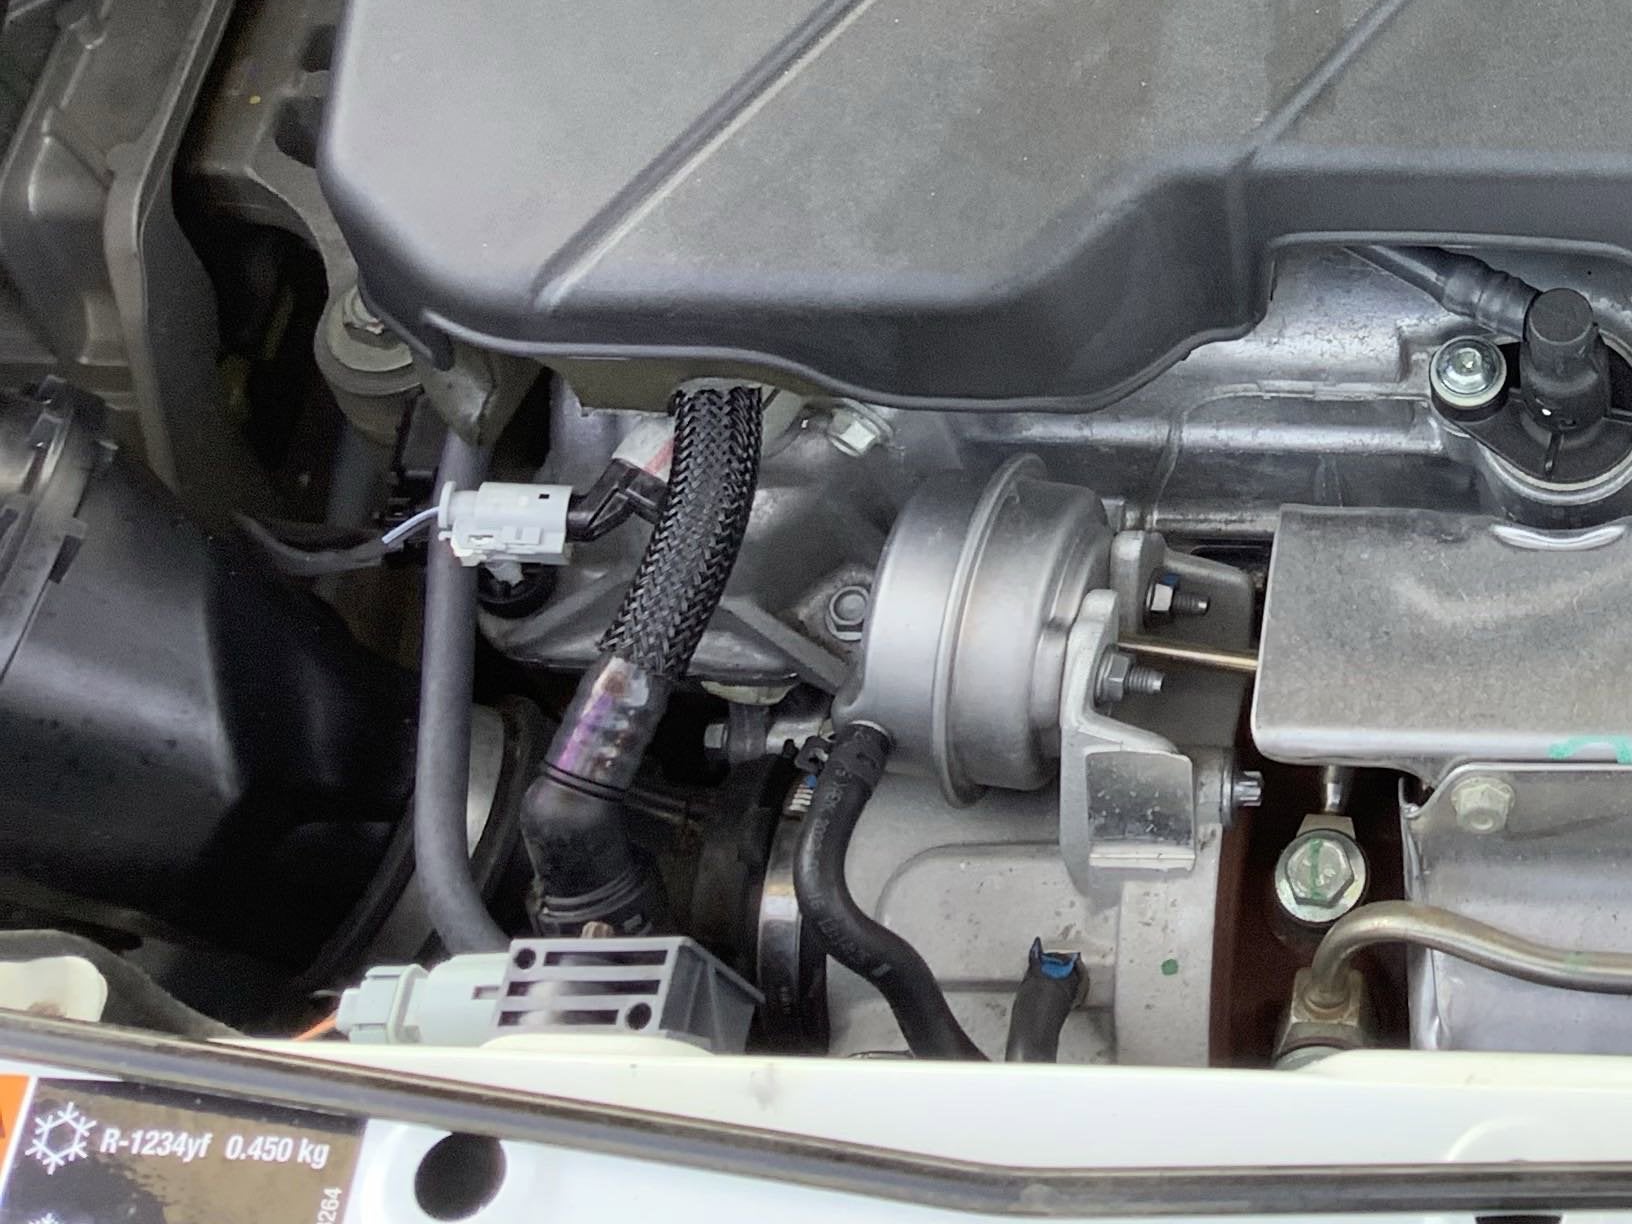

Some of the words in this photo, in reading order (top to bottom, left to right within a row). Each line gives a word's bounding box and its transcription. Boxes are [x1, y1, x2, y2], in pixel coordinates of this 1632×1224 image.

[99, 1128, 213, 1162] R-1234yf
[224, 1135, 295, 1163] 0.450
[297, 1136, 331, 1170] kg
